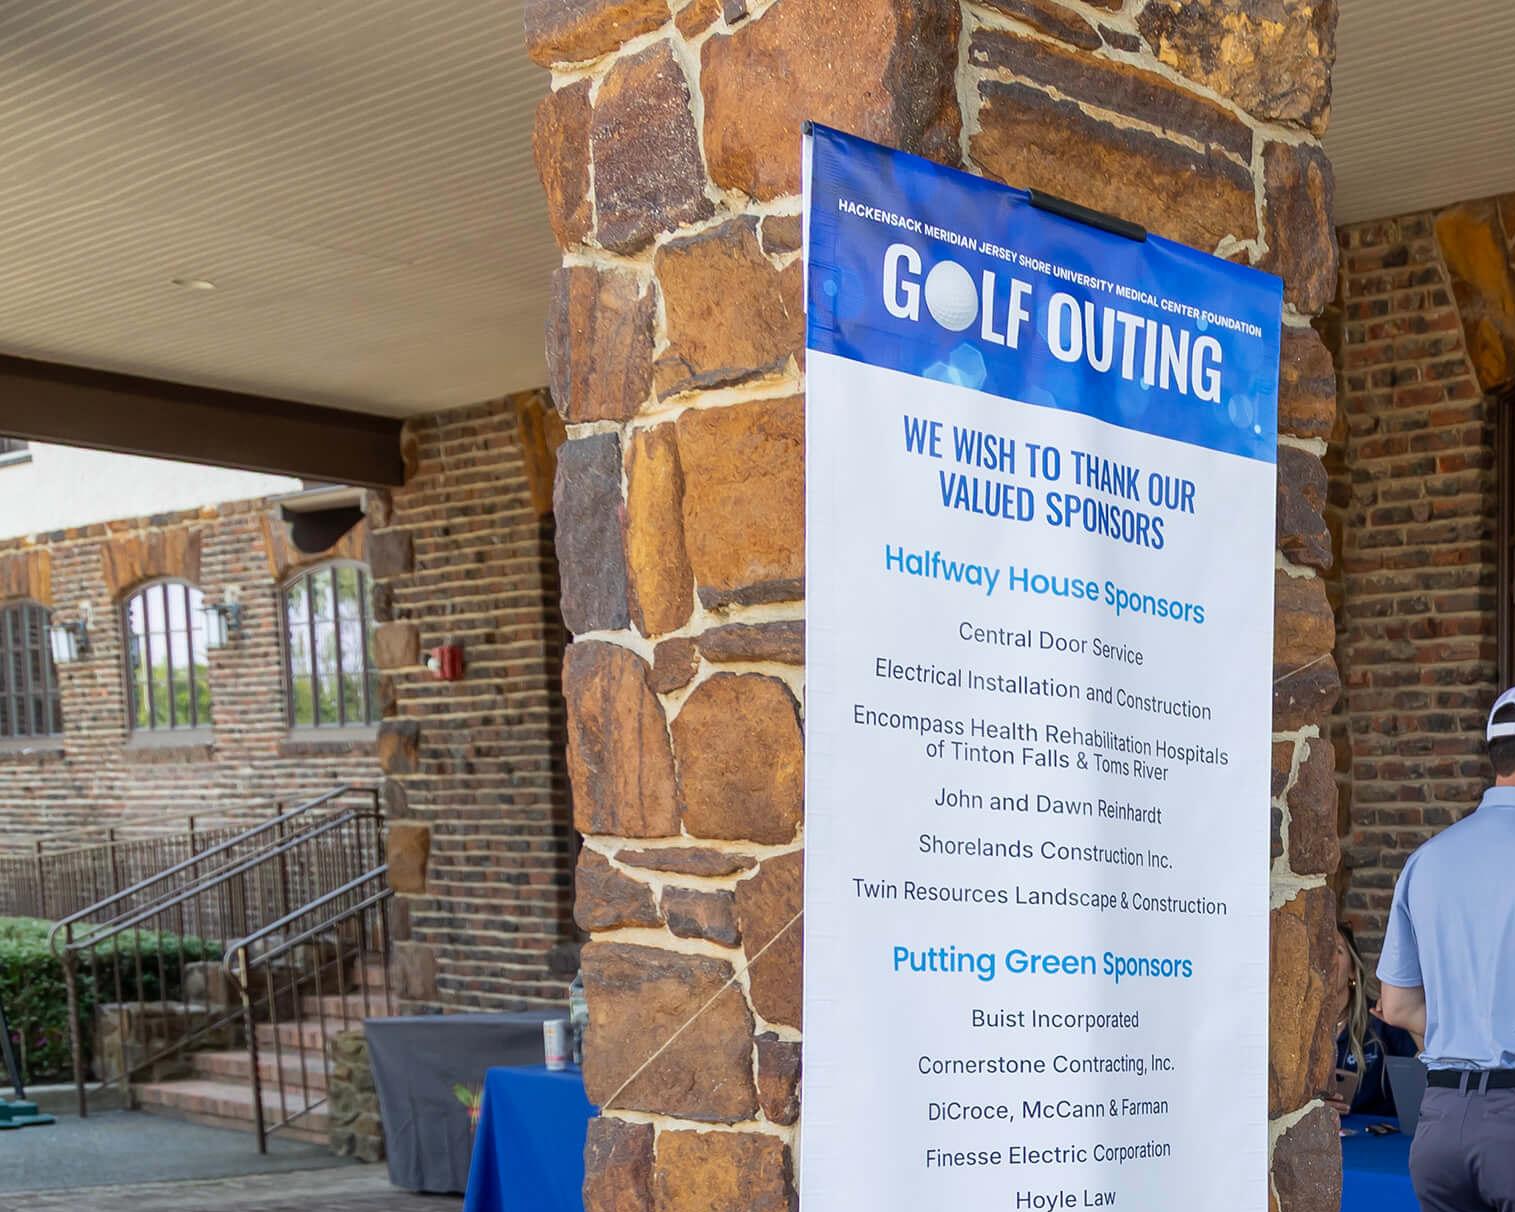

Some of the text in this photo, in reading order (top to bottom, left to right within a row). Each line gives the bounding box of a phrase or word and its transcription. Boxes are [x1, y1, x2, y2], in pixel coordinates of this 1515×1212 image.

[839, 200, 1261, 337] HACKENSACK MERIDIAN JERSEY SHORE UNIVERSITY MEDICAL CENTER FOUNDATION
[883, 243, 1222, 403] GOLF OUTING
[903, 414, 1196, 515] WE WISH TO THANK OUR
[938, 469, 1165, 551] VALUED SPONSORS
[885, 543, 1206, 625] Halfway House Sponsors
[959, 621, 1144, 666] Central Door Service
[875, 657, 1212, 721] Electrical Installation and Construction
[853, 703, 1229, 766] Encompass Health Rehabilitation Hospitals
[926, 739, 1169, 781] of Tinton Falls & Toms River
[934, 787, 1162, 825] John and Dawn Reinhardt
[919, 833, 1173, 870] Shorelands Construction Inc.
[851, 877, 1227, 916] Twin Resources Landscape & Construction
[893, 944, 1193, 985] Putting Green Sponsors
[972, 1008, 1139, 1033] Buist Incorporated
[918, 1053, 1175, 1077] Cornerstone Contracting, Inc.
[928, 1098, 1169, 1123] DiCroce, McCann & Farman
[926, 1141, 1171, 1169] Finesse Electric Corporation
[1083, 1189, 1117, 1208] Law
